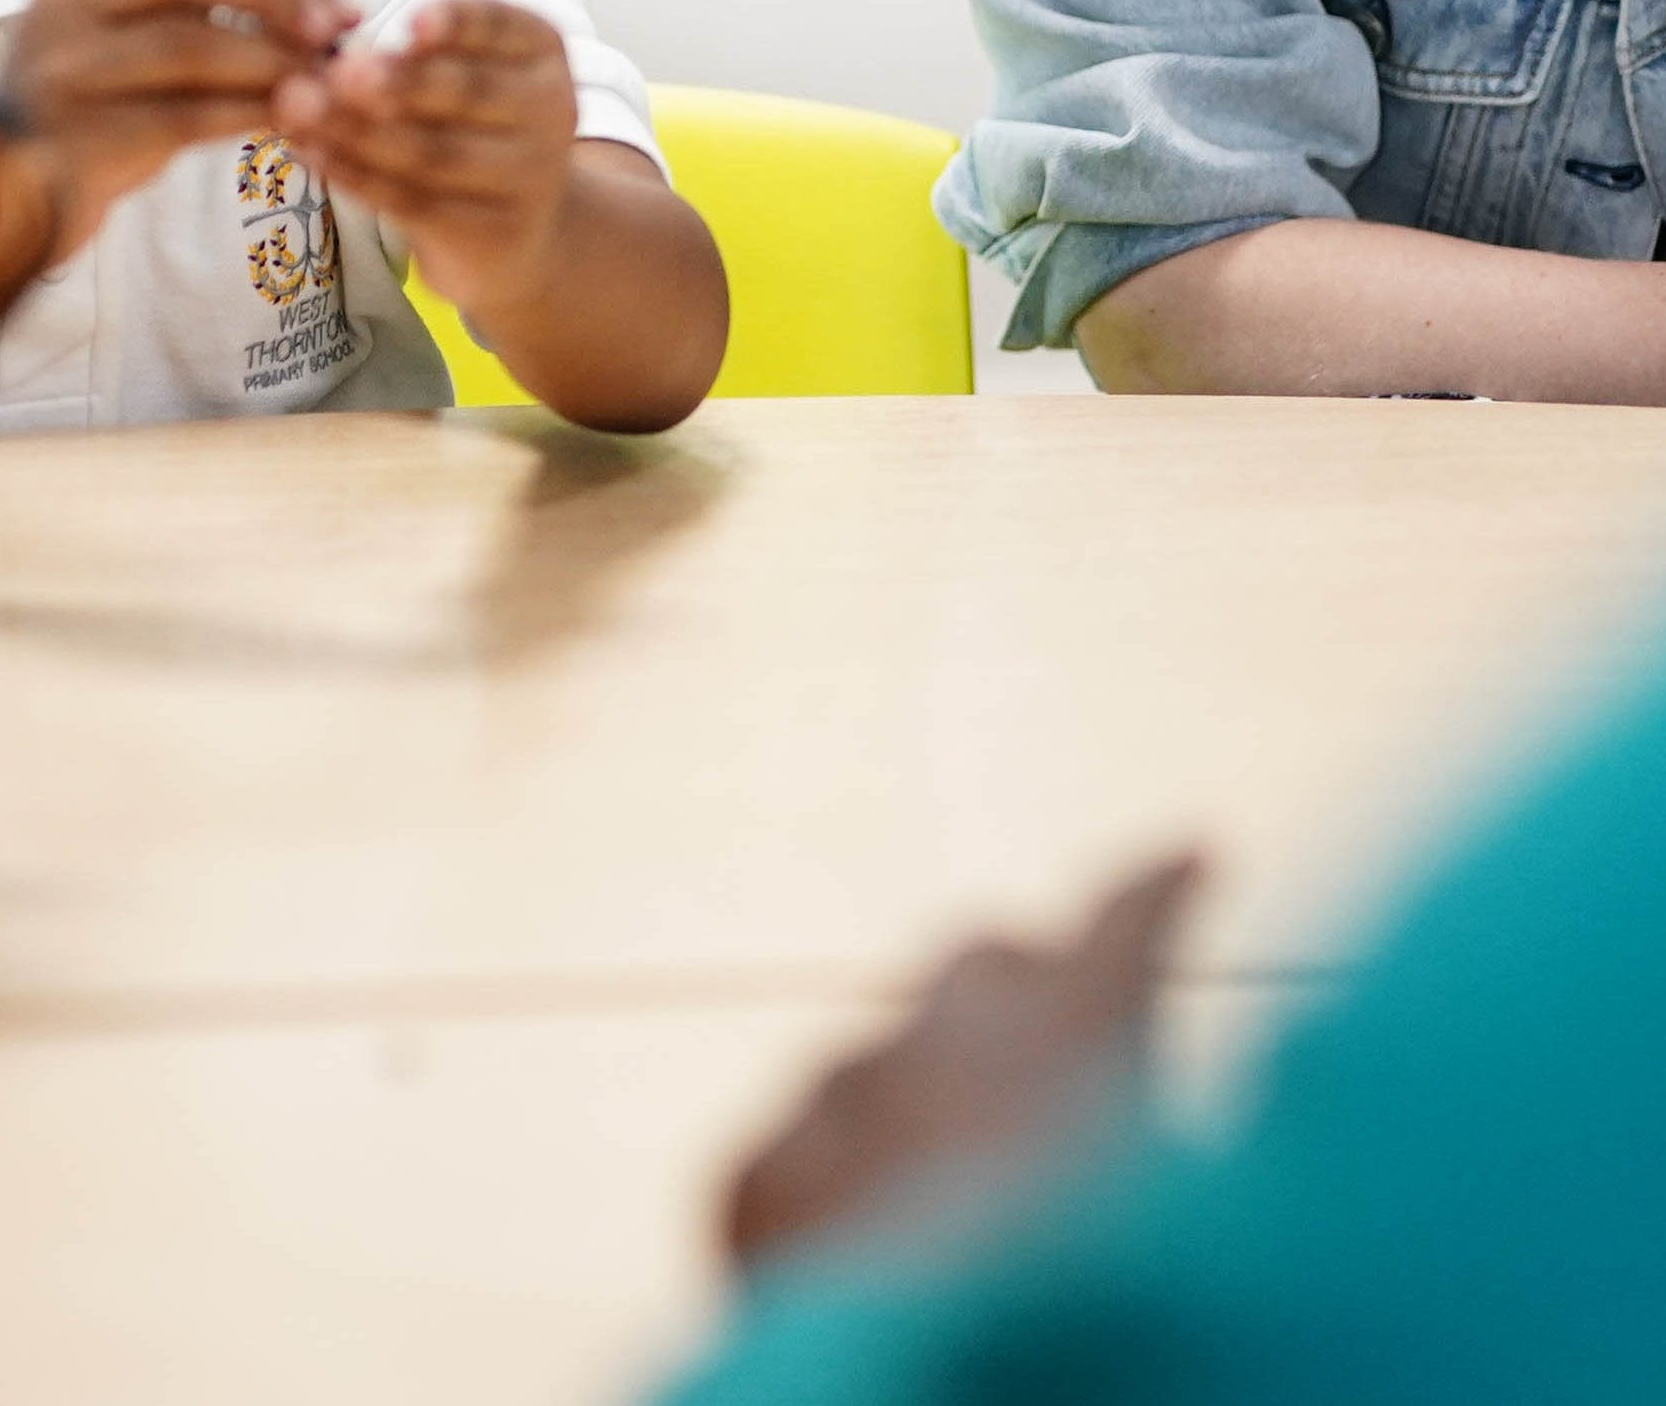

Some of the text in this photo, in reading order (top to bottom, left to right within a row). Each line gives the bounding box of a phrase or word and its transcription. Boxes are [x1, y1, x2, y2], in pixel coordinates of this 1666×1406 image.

[278, 290, 331, 332] WEST
[244, 308, 349, 369] THORNTON
[243, 360, 305, 392] PRIMARY
